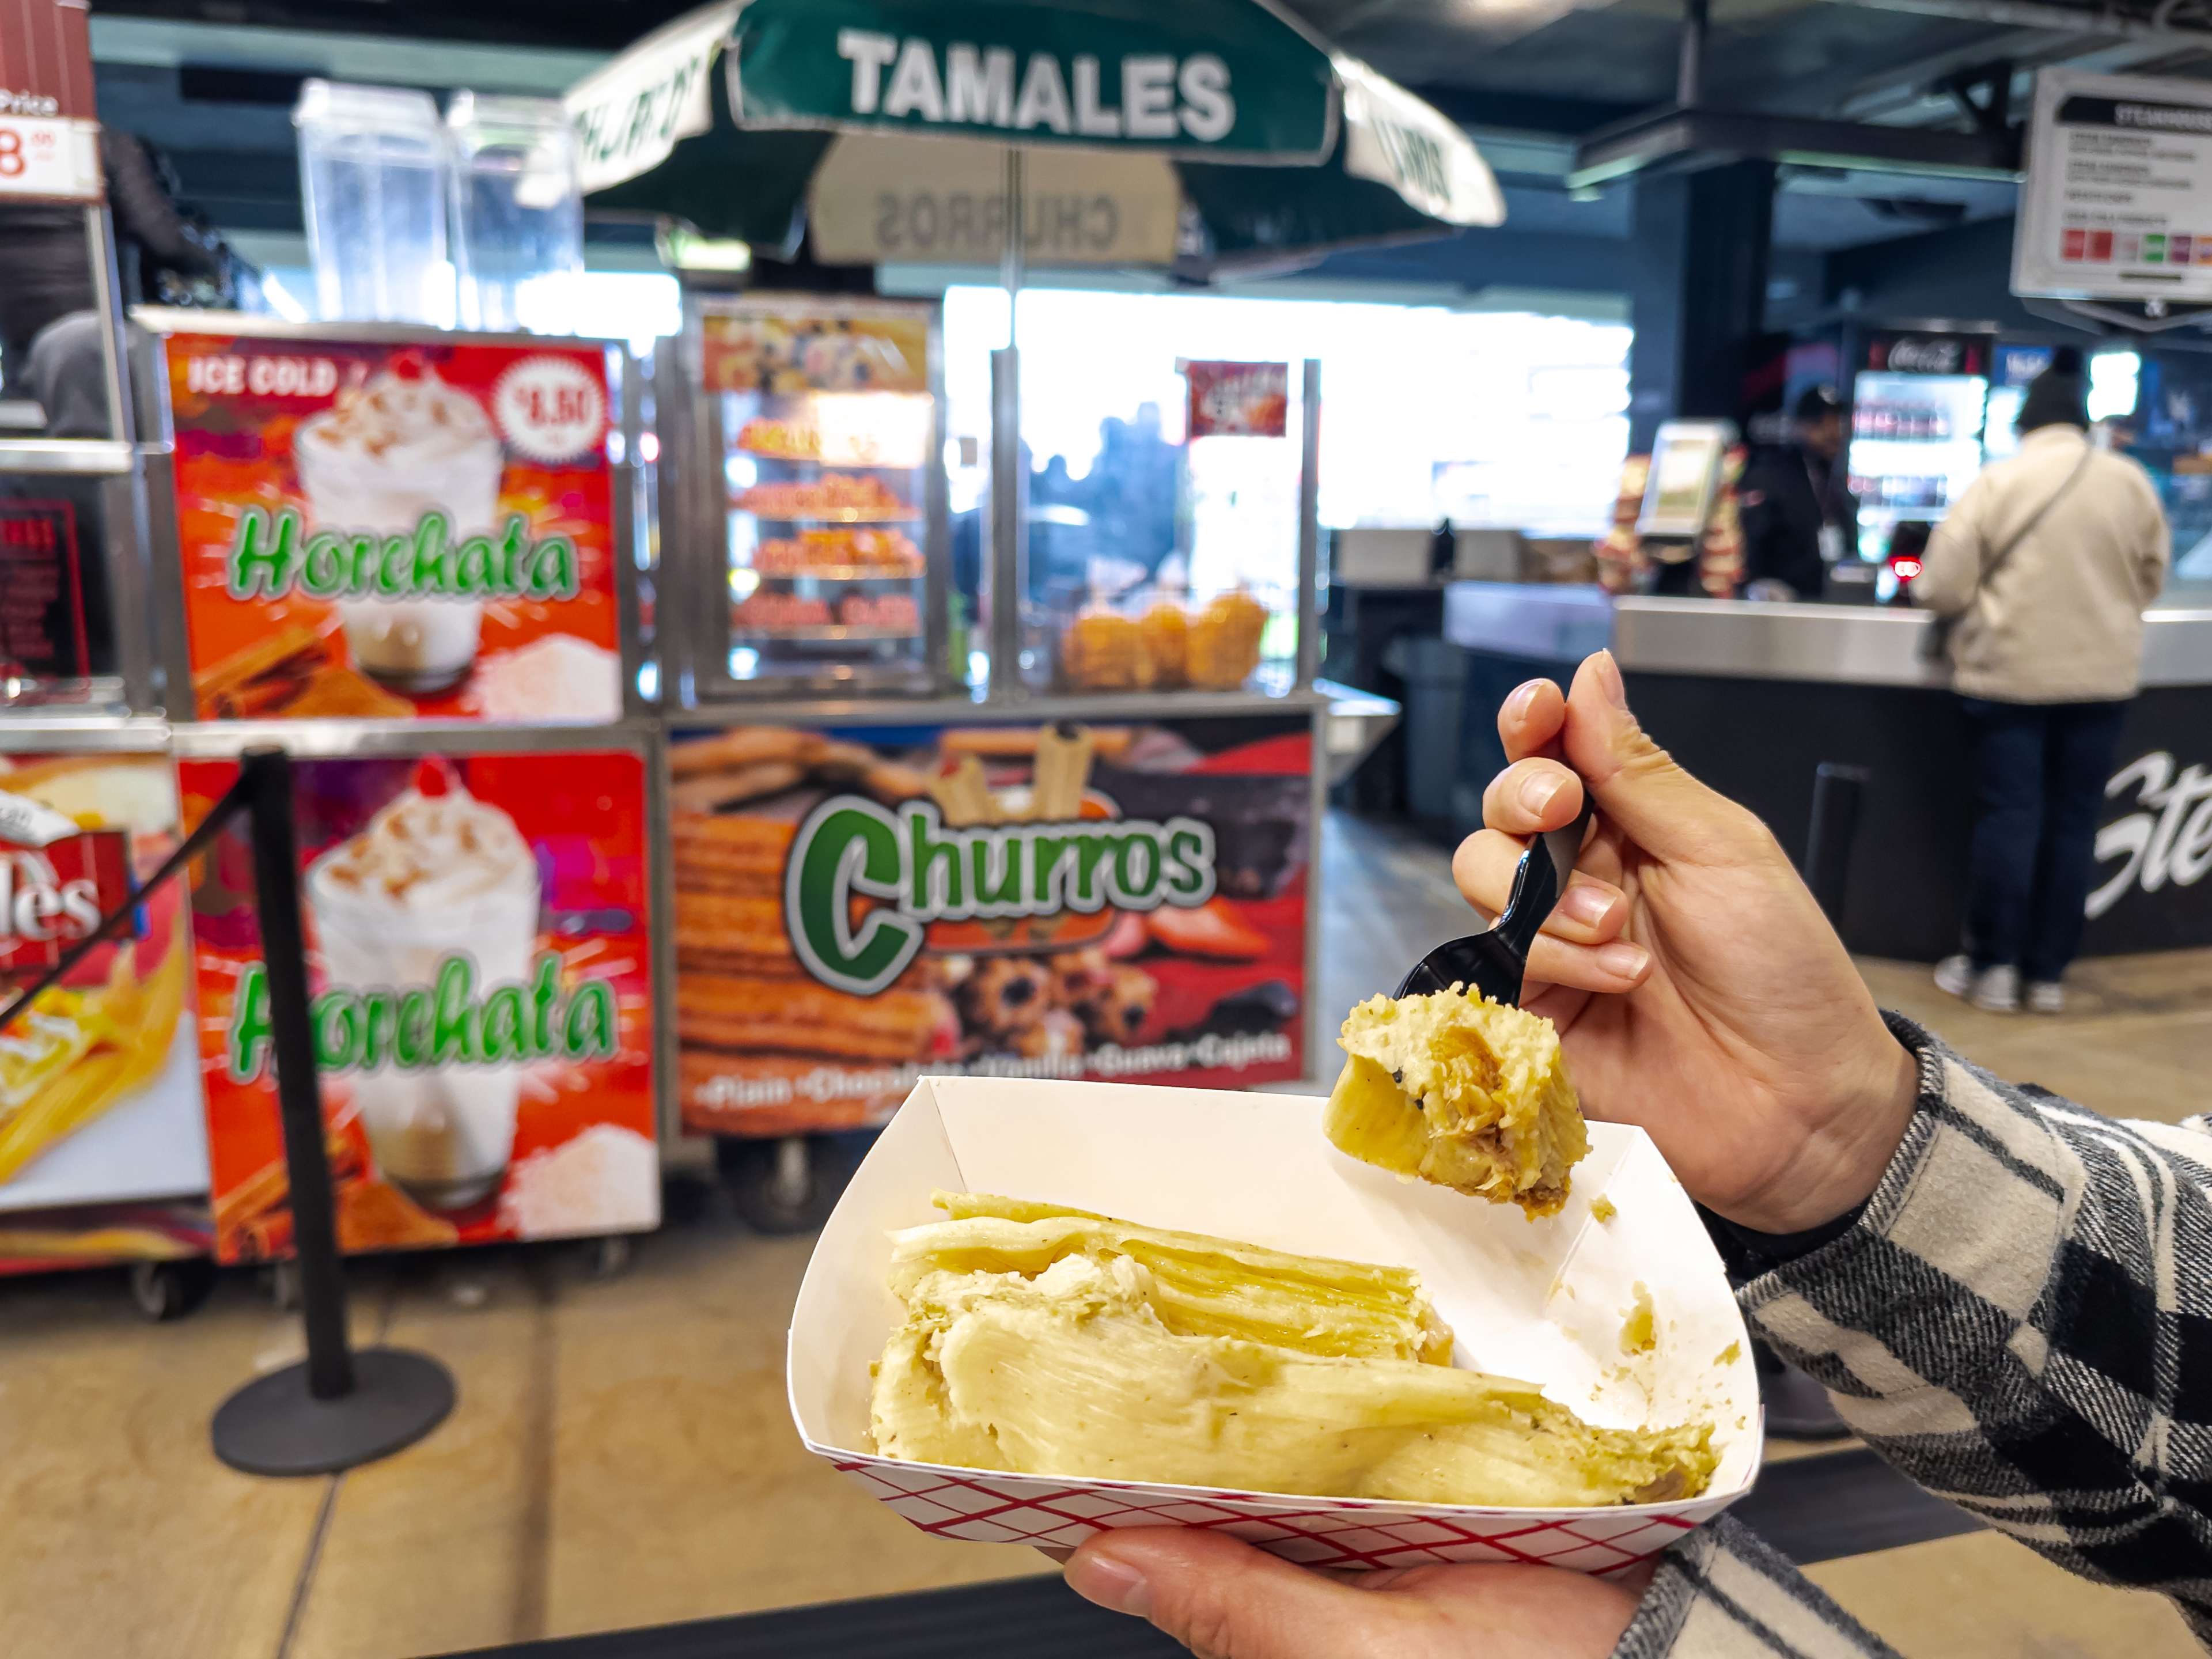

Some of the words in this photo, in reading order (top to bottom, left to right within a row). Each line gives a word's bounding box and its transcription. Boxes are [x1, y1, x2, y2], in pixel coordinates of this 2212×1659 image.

[837, 28, 1237, 142] TAMALES
[187, 355, 246, 393] ICE
[248, 355, 339, 397] COLD
[226, 503, 581, 601] Horchata
[786, 794, 1215, 996] Churros
